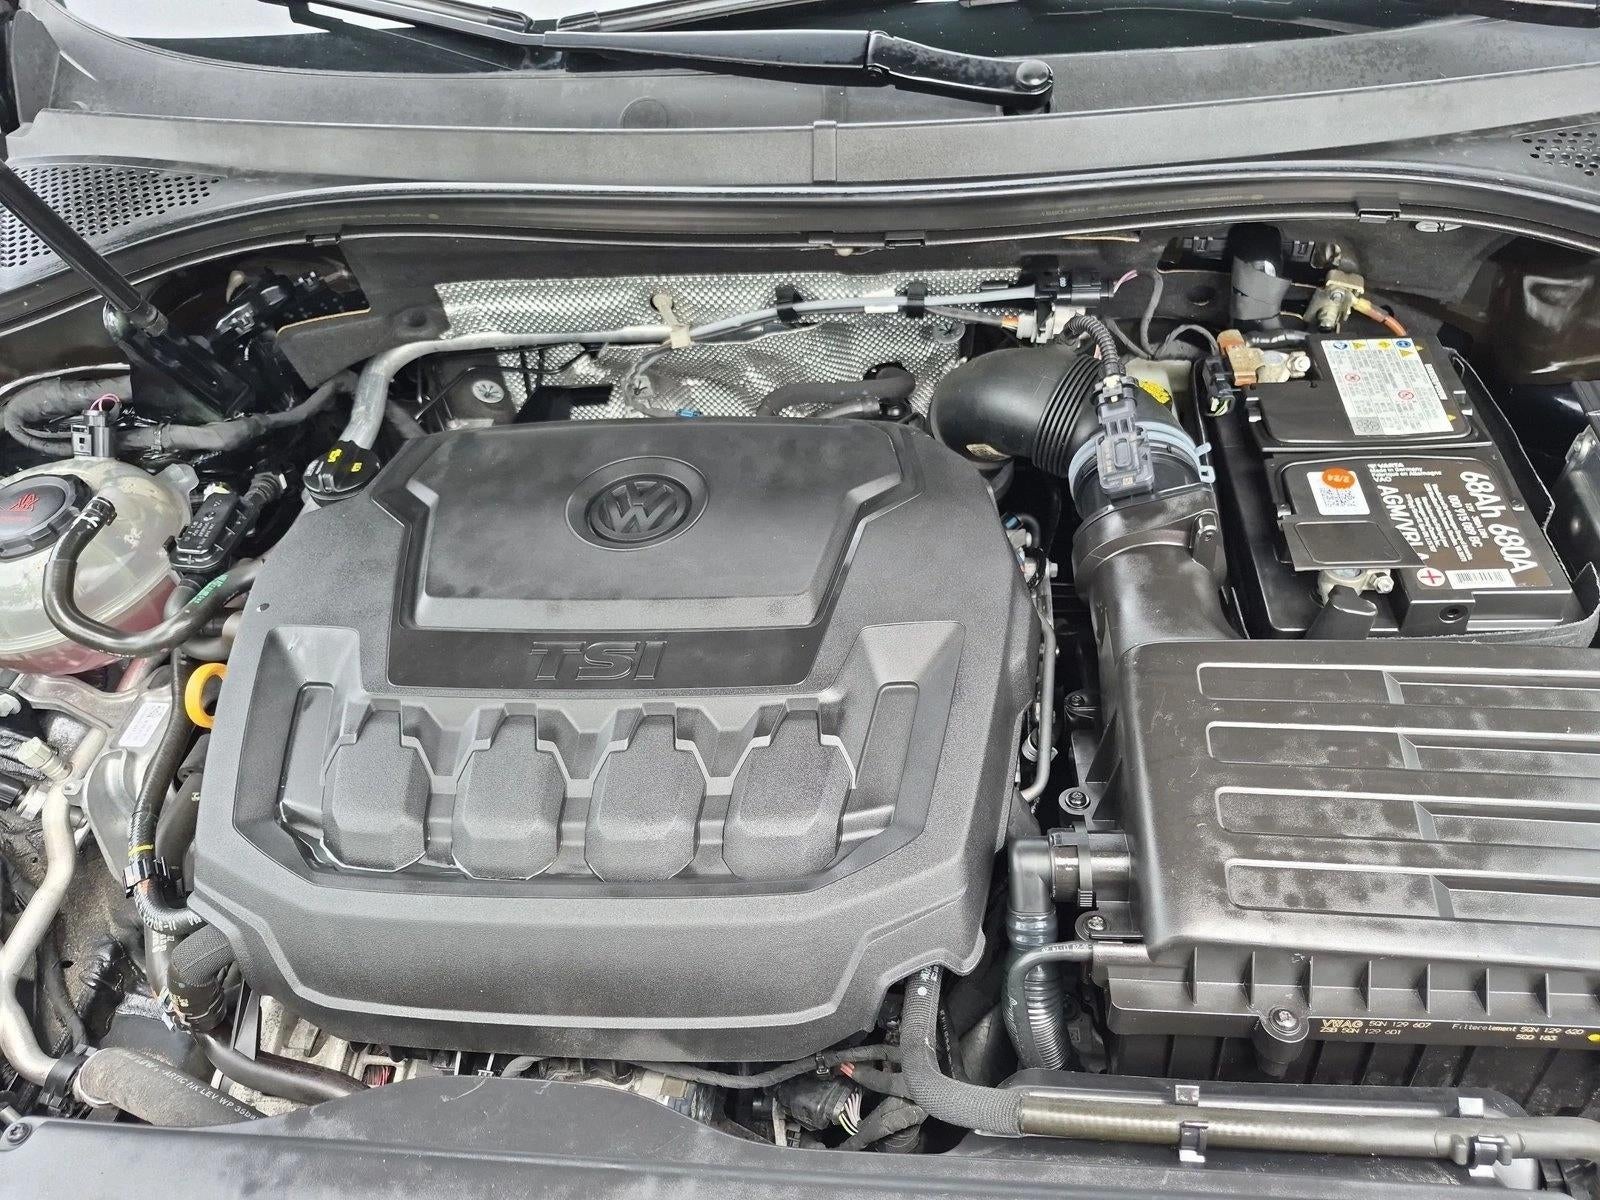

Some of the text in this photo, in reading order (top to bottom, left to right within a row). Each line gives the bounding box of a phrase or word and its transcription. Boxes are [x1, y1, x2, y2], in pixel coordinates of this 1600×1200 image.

[597, 478, 681, 537] VW
[1460, 471, 1538, 574] 68Ah 680A
[529, 640, 669, 681] TSI
